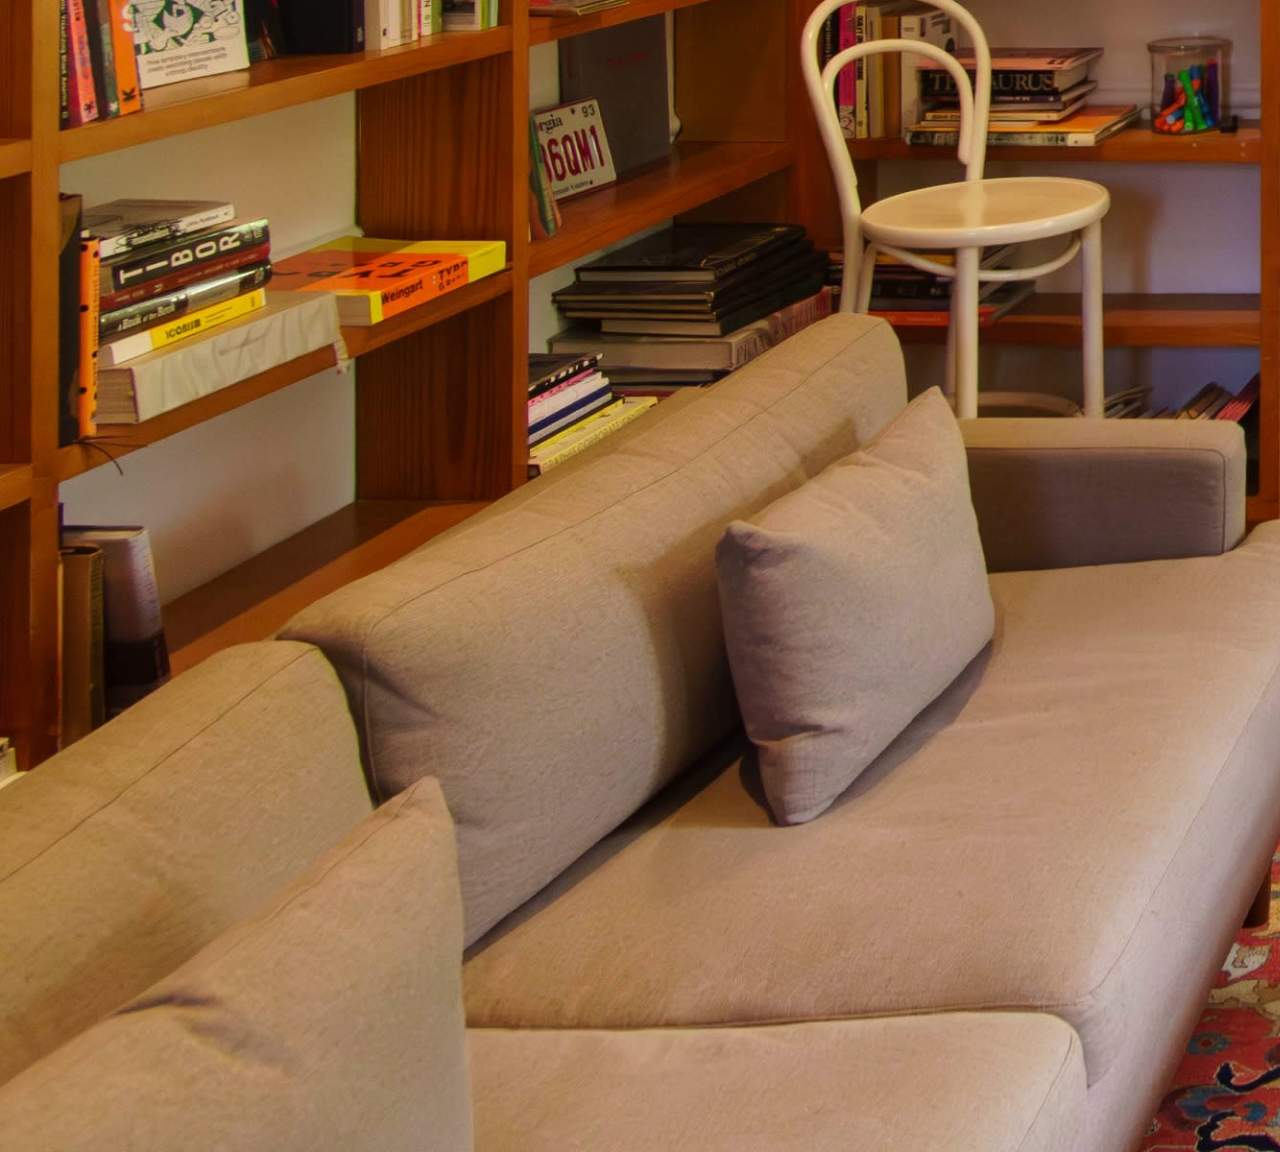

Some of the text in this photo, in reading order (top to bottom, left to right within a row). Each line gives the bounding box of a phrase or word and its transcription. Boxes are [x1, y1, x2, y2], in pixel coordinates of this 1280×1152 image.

[929, 72, 1055, 91] THAURUS
[540, 104, 596, 134] rgia 93
[540, 125, 605, 182] 6QM1
[119, 232, 242, 285] TIBOR
[382, 279, 424, 305] Weingart
